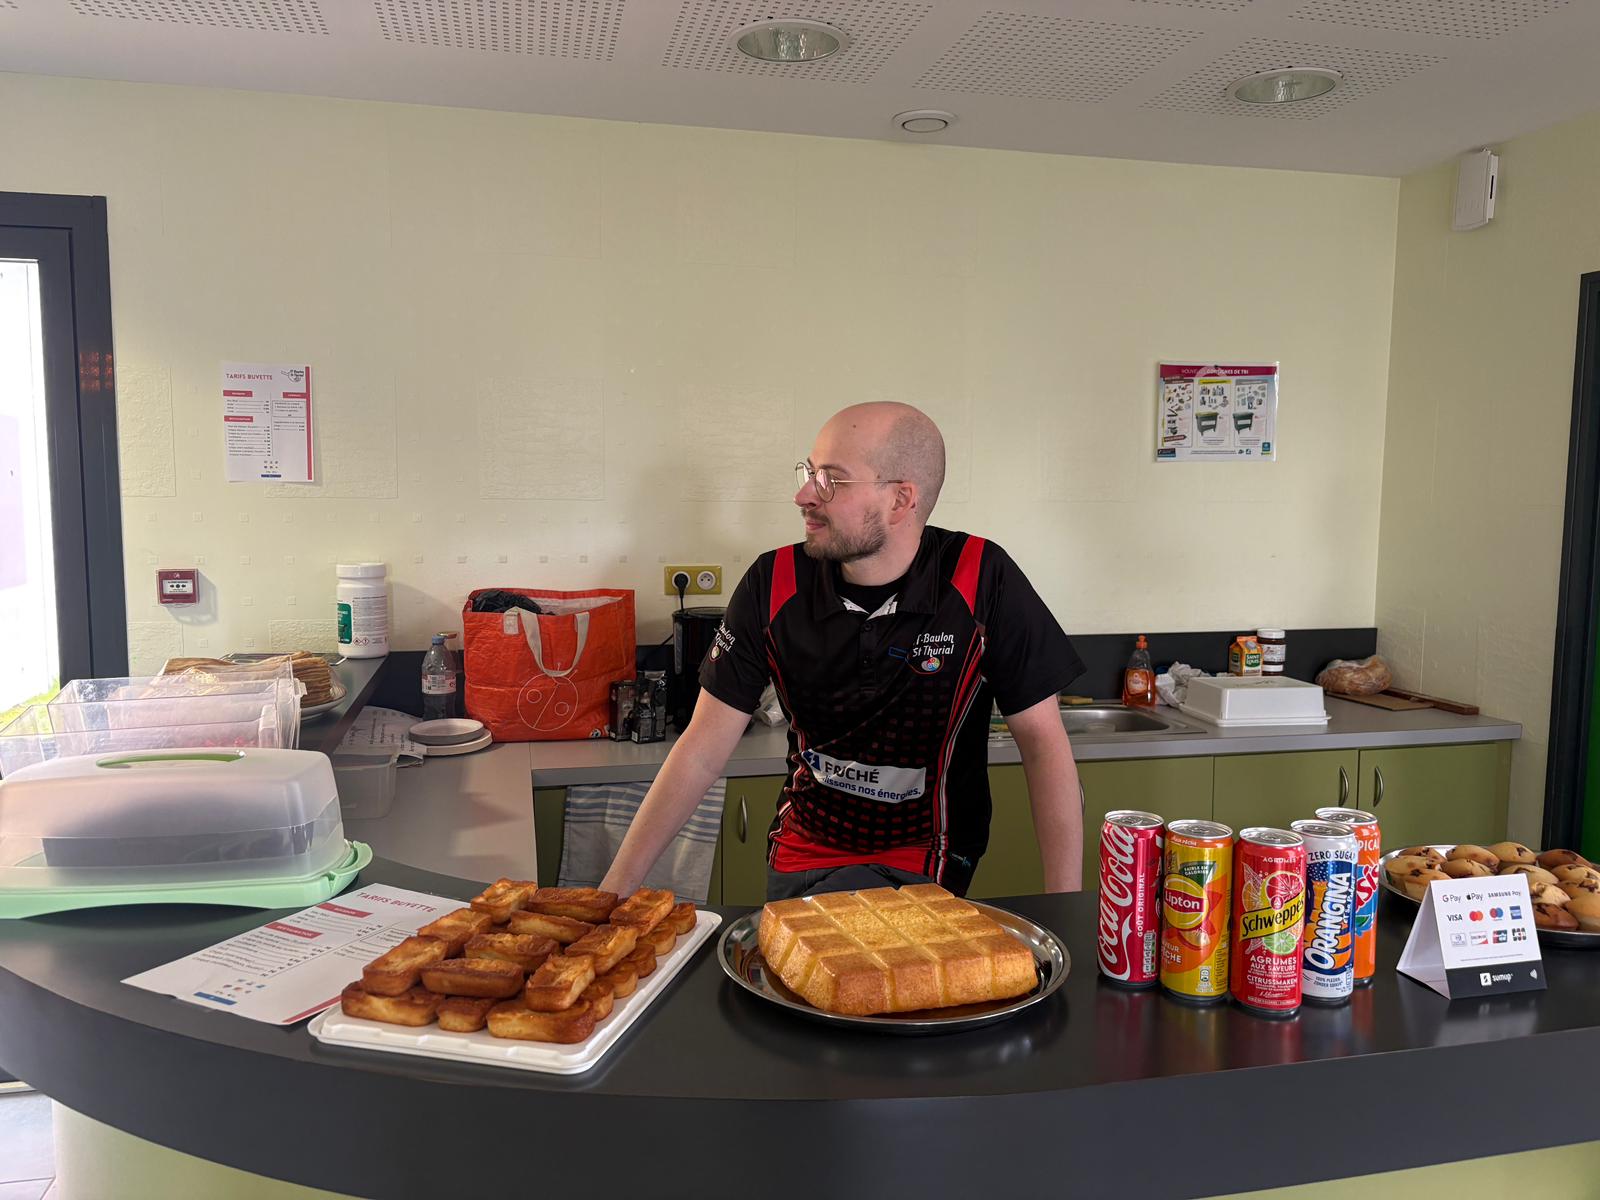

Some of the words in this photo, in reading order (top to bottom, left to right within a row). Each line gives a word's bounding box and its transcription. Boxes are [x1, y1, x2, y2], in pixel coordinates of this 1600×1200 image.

[912, 646, 922, 658] St
[923, 644, 955, 658] Thurial
[858, 785, 876, 797] nos
[1308, 850, 1331, 861] ZERO
[1137, 872, 1145, 913] ORIGINAL
[1471, 893, 1483, 901] Pay
[357, 892, 392, 903] TARIFS
[391, 899, 437, 913] BUVETTE
[1165, 890, 1200, 910] Lipton
[1443, 895, 1449, 903] G
[1450, 895, 1462, 904] Pay
[1304, 872, 1350, 970] ORANGINA
[1446, 914, 1463, 922] VISA
[1136, 912, 1144, 938] GOÛT
[1250, 955, 1297, 966] AGRUMES
